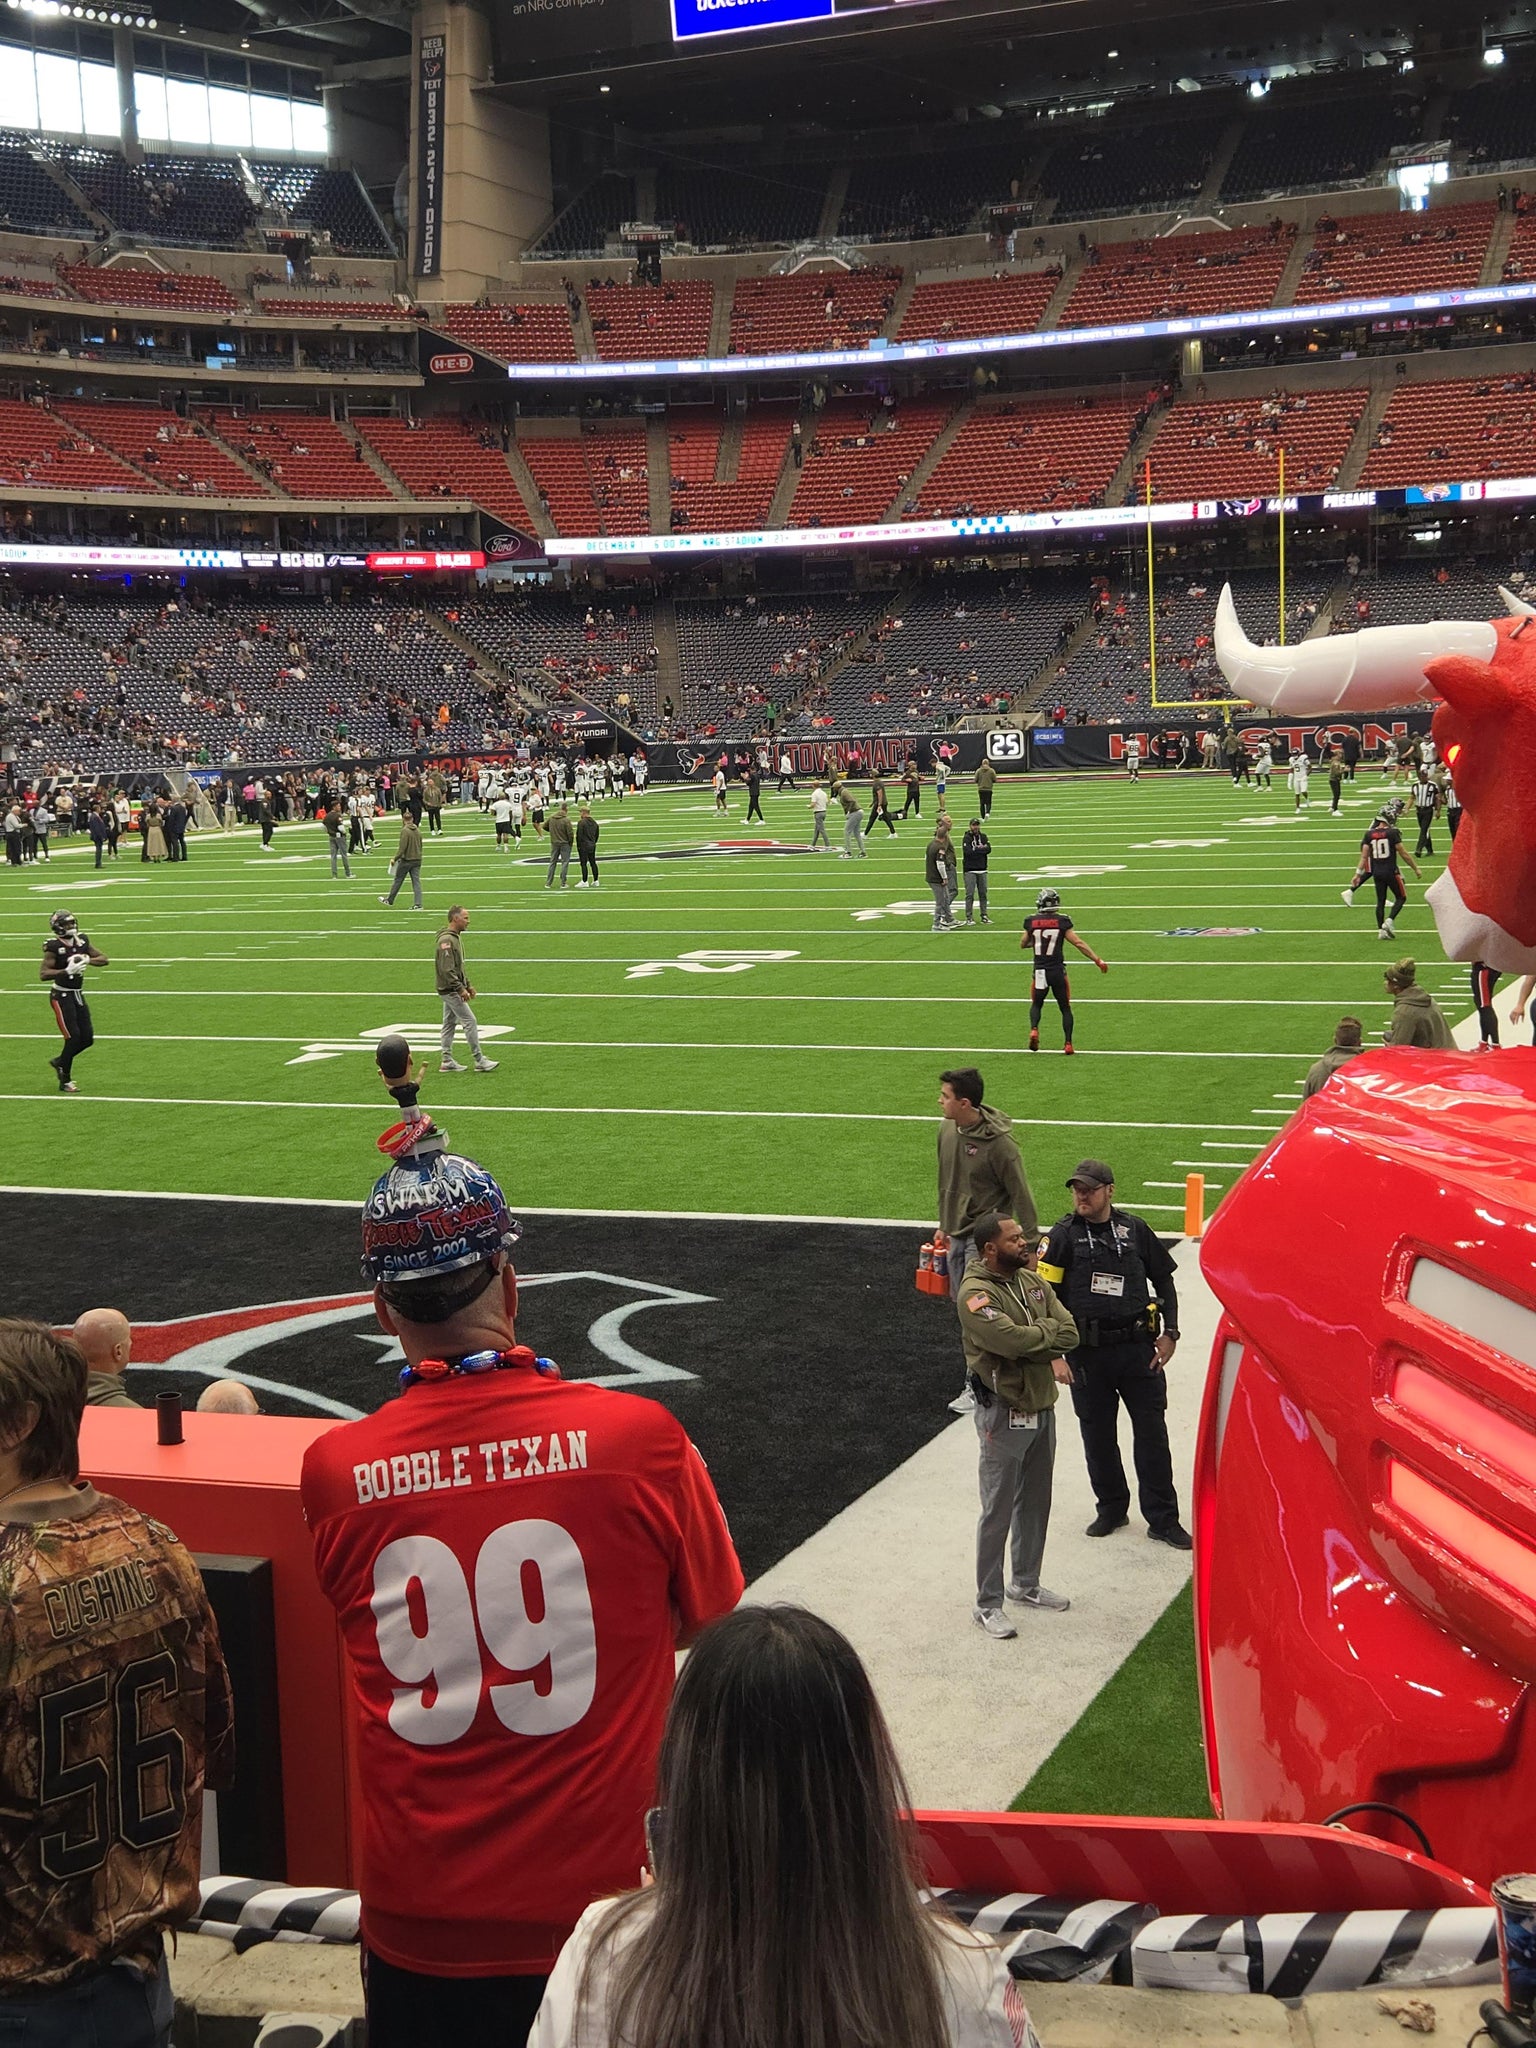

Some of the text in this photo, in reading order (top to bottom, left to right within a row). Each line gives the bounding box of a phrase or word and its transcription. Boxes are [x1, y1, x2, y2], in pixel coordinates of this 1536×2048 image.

[513, 4, 526, 15] an
[528, 0, 553, 12] NRG
[423, 38, 442, 49] NEED
[421, 47, 444, 59] HELP?
[423, 79, 442, 90] TEXT
[1320, 307, 1345, 316] START
[1323, 492, 1377, 508] PREGAME
[586, 541, 635, 551] DECEMBER
[724, 536, 763, 546] STADIUM
[992, 734, 1018, 756] 25
[513, 792, 521, 804] 9
[1370, 839, 1390, 859] 10
[1032, 928, 1060, 956] 17
[371, 1176, 471, 1221] SWARM
[383, 1237, 472, 1270] SINCE 2002
[353, 1429, 588, 1504] BOBBLE TEXAN
[42, 1556, 157, 1641] CUSHING
[370, 1518, 598, 1746] 99
[39, 1649, 189, 1881] 56
